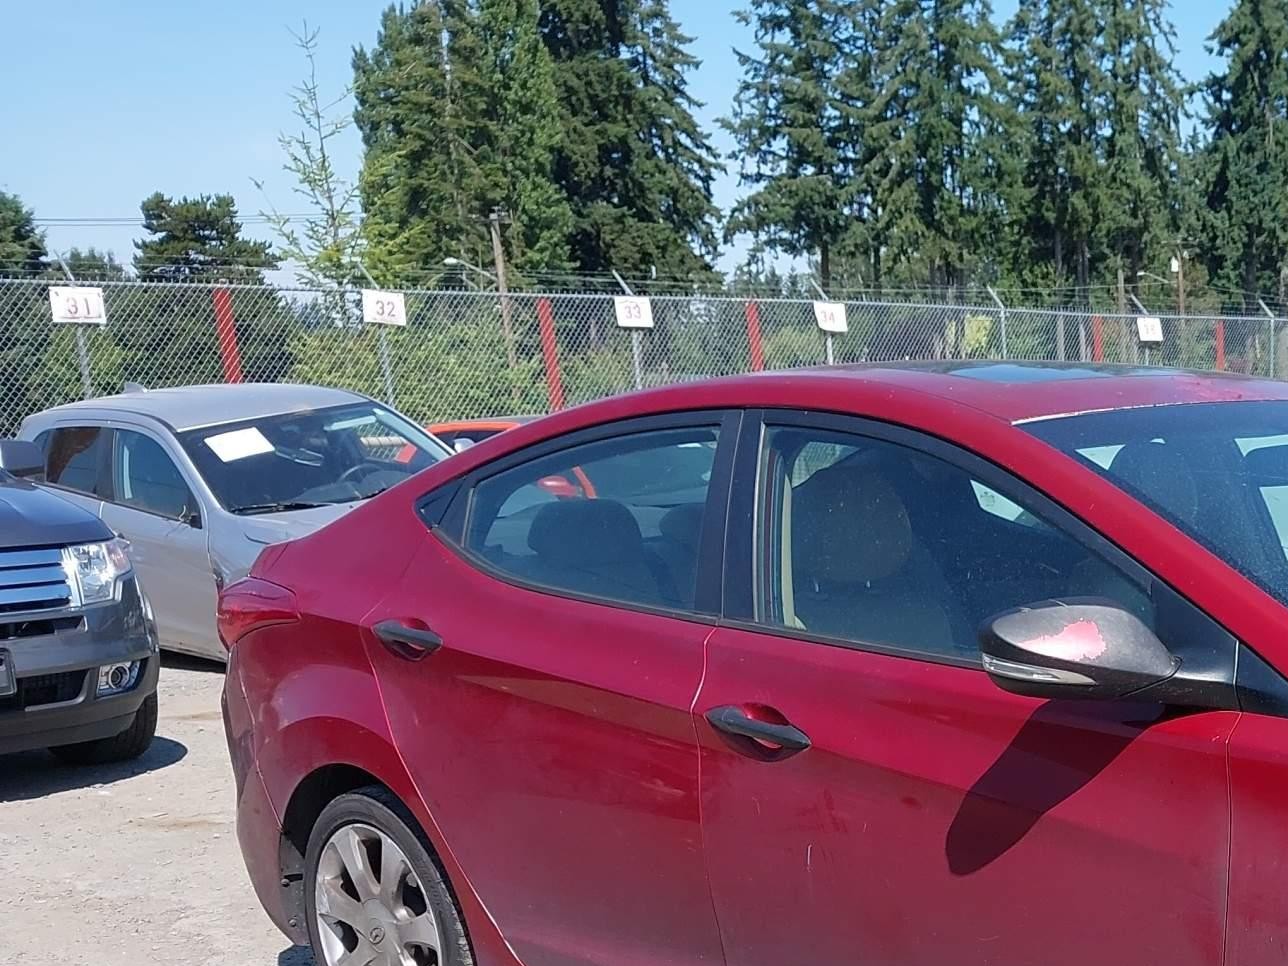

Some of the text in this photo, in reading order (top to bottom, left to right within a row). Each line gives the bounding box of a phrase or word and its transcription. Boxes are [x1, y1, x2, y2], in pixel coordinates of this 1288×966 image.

[66, 296, 91, 316] 31
[375, 300, 396, 317] 32
[624, 303, 642, 319] 33
